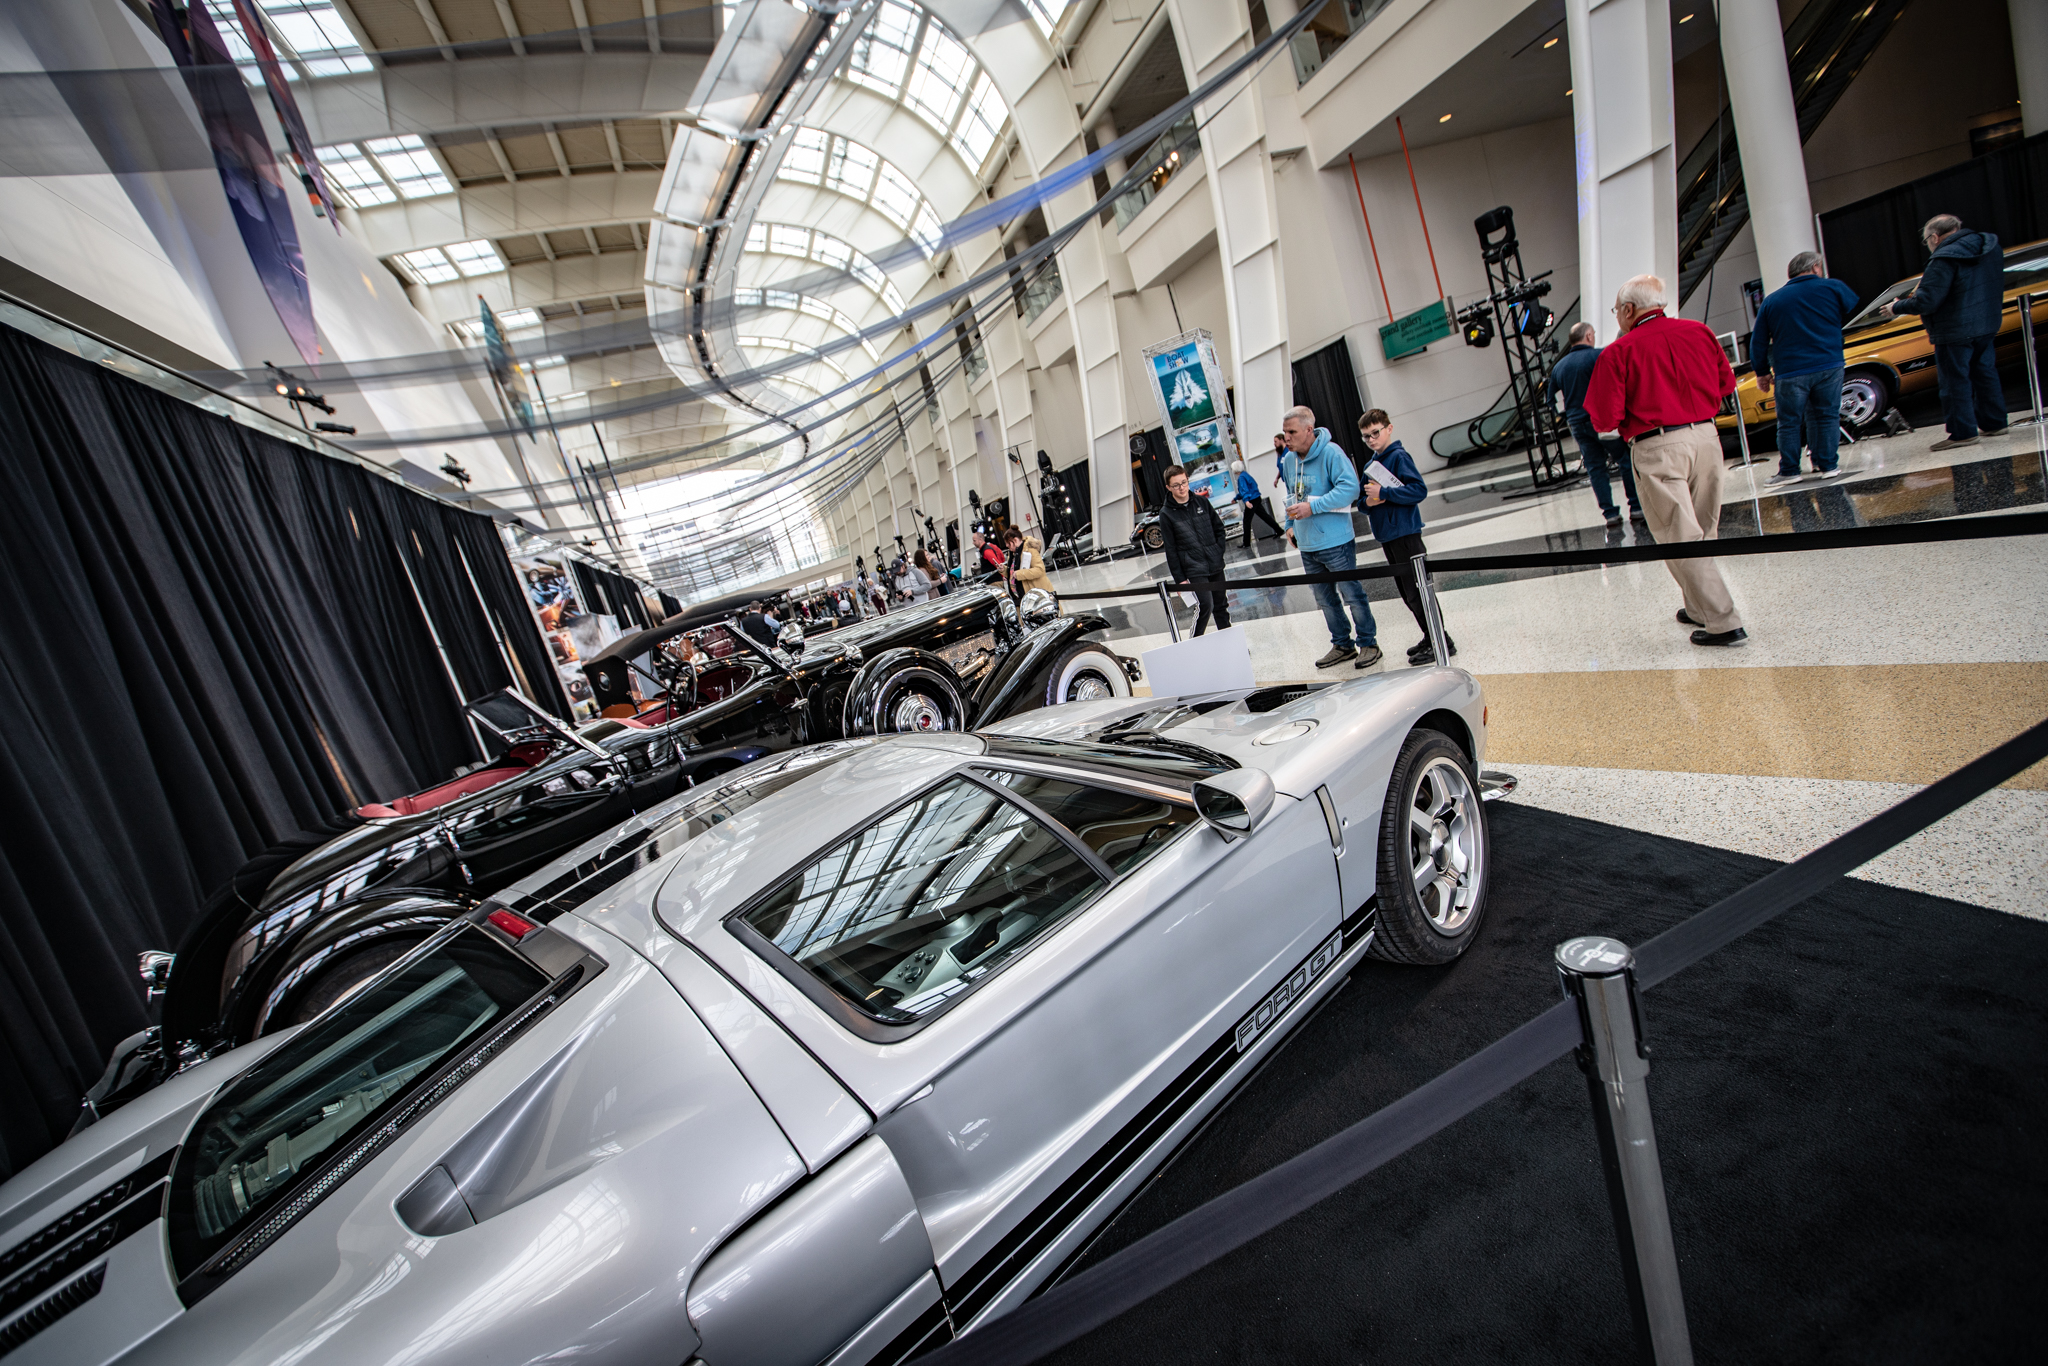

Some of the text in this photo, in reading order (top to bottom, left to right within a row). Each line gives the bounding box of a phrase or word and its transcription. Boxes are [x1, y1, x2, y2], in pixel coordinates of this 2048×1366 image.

[1381, 322, 1399, 340] grand
[1400, 315, 1422, 331] gallery
[1166, 350, 1185, 363] BOAT
[1135, 438, 1144, 448] E
[1237, 933, 1341, 1049] FORD GT
